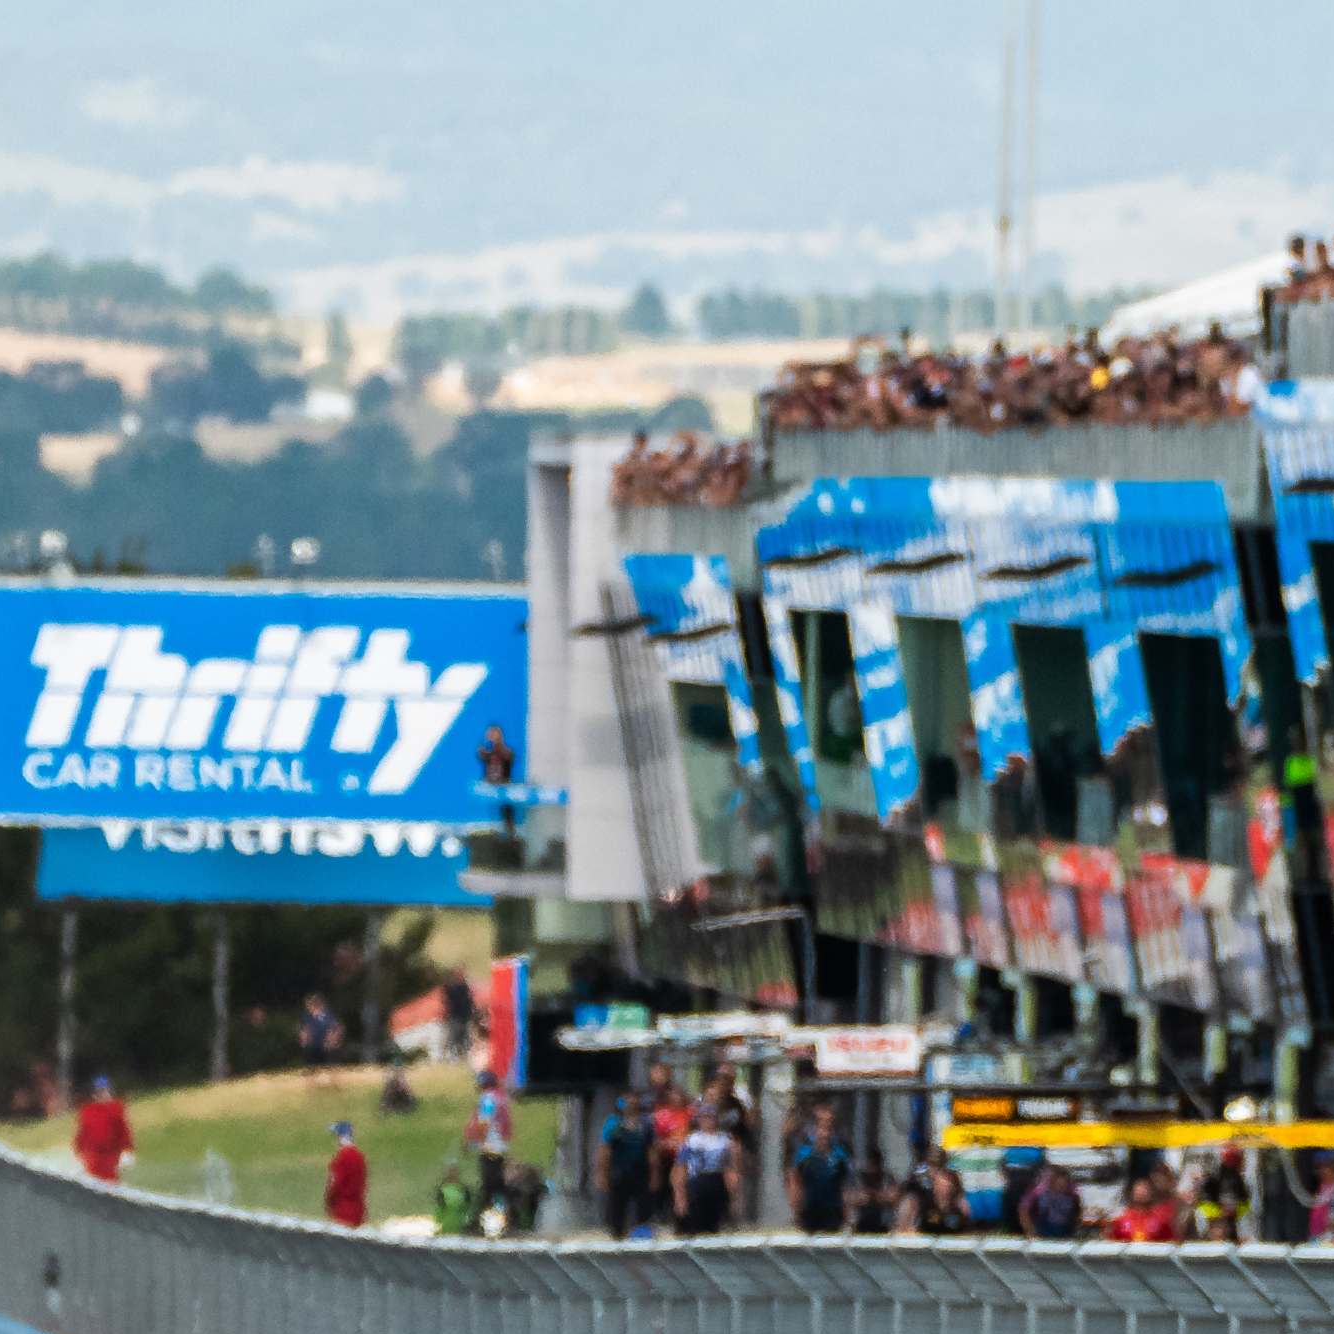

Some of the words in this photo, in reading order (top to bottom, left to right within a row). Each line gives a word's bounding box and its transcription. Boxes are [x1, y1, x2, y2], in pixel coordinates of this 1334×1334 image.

[25, 623, 487, 795] Thrifty
[22, 752, 120, 789] CAR
[134, 754, 313, 793] RENTAL
